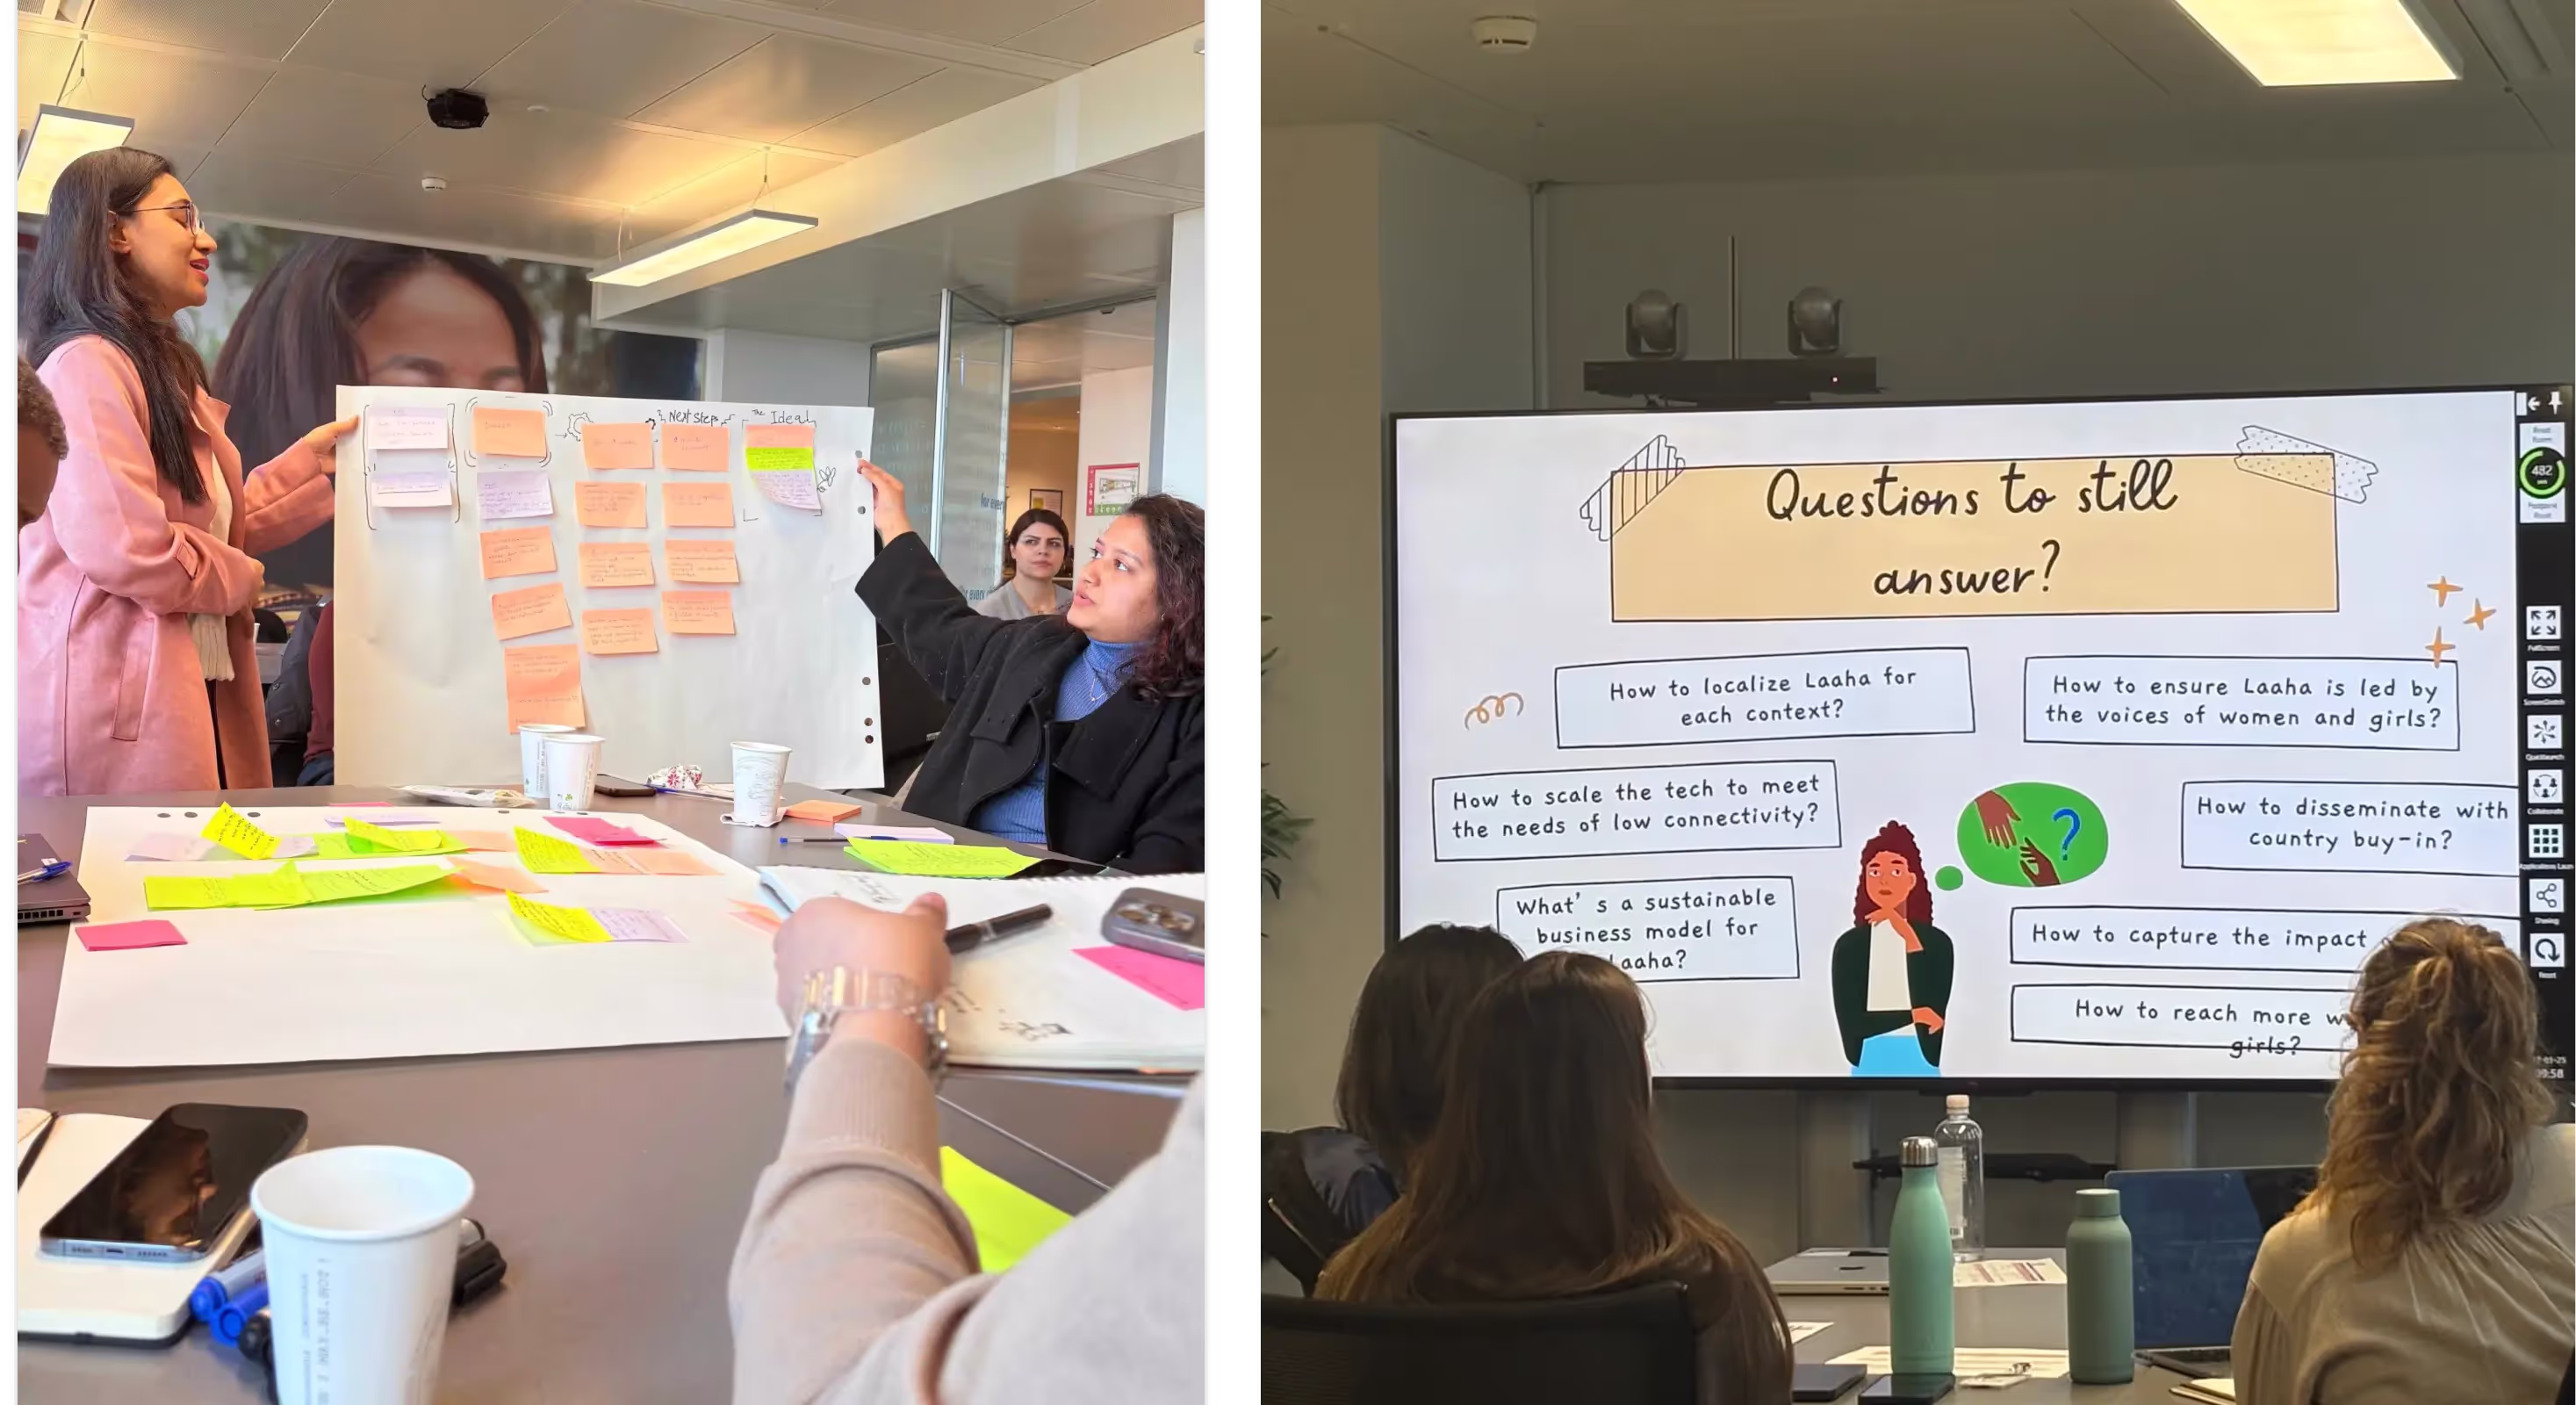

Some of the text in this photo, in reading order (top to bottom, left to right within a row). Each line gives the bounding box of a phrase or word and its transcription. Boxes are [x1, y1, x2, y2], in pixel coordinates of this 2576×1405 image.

[669, 408, 692, 423] Next
[1766, 458, 2179, 522] Questions to still
[1874, 539, 2061, 595] answer?
[1610, 666, 1917, 702] How to localize Laaha for
[2053, 674, 2438, 704] How to ensure Laaha is led by
[1680, 698, 1844, 726] each context?
[2045, 703, 2442, 733] the voices of women and girls?
[1453, 774, 1819, 811] How to scale the tech to meet
[1451, 802, 1818, 839] the needs of low connectivity?
[2198, 796, 2508, 819] How to disseminate with
[2249, 828, 2452, 855] country buy-in?
[1621, 898, 1634, 911] a
[1644, 888, 1776, 911] sustainable
[1536, 916, 1759, 945] business model for
[2033, 923, 2367, 951] How to capture the impact
[2076, 998, 2124, 1018] How
[2136, 1000, 2158, 1020] to
[2174, 1003, 2238, 1022] reach
[2253, 1010, 2312, 1027] more
[2230, 1034, 2303, 1058] girls?
